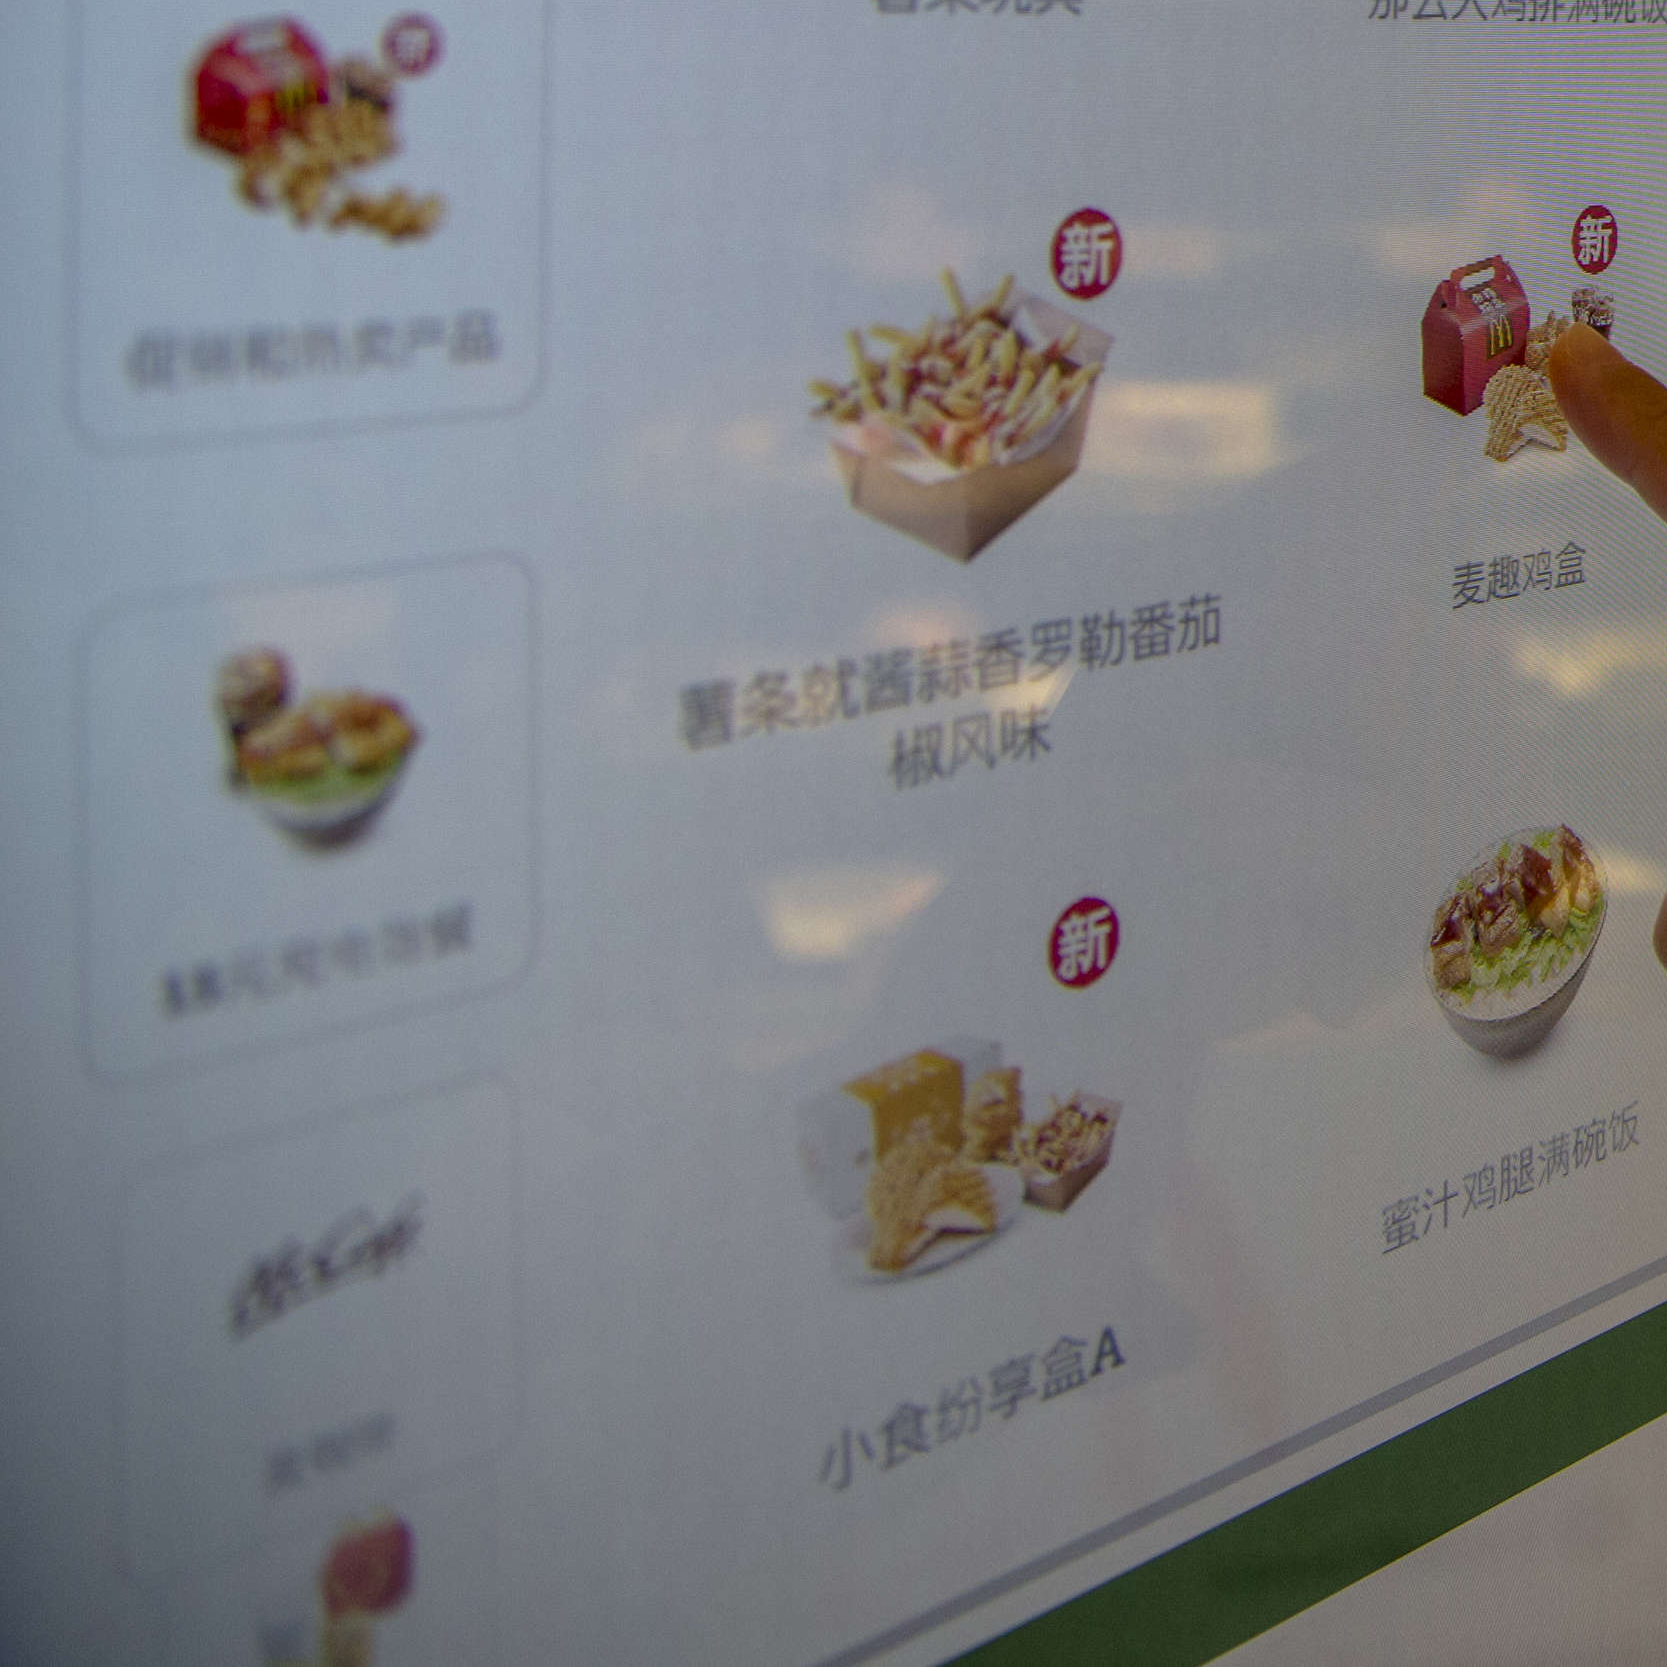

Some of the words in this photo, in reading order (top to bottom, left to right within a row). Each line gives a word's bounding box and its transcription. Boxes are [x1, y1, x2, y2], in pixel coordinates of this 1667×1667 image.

[1059, 223, 1115, 289] 新
[1577, 214, 1613, 266] 新
[1452, 541, 1587, 610] 麦趣鸡盒
[887, 704, 1053, 792] 椒风味
[1057, 907, 1111, 981] 新
[1382, 1100, 1640, 1256] 蜜汁鸡腿满碗饭
[819, 1326, 1127, 1494] 小食纷享盒A
